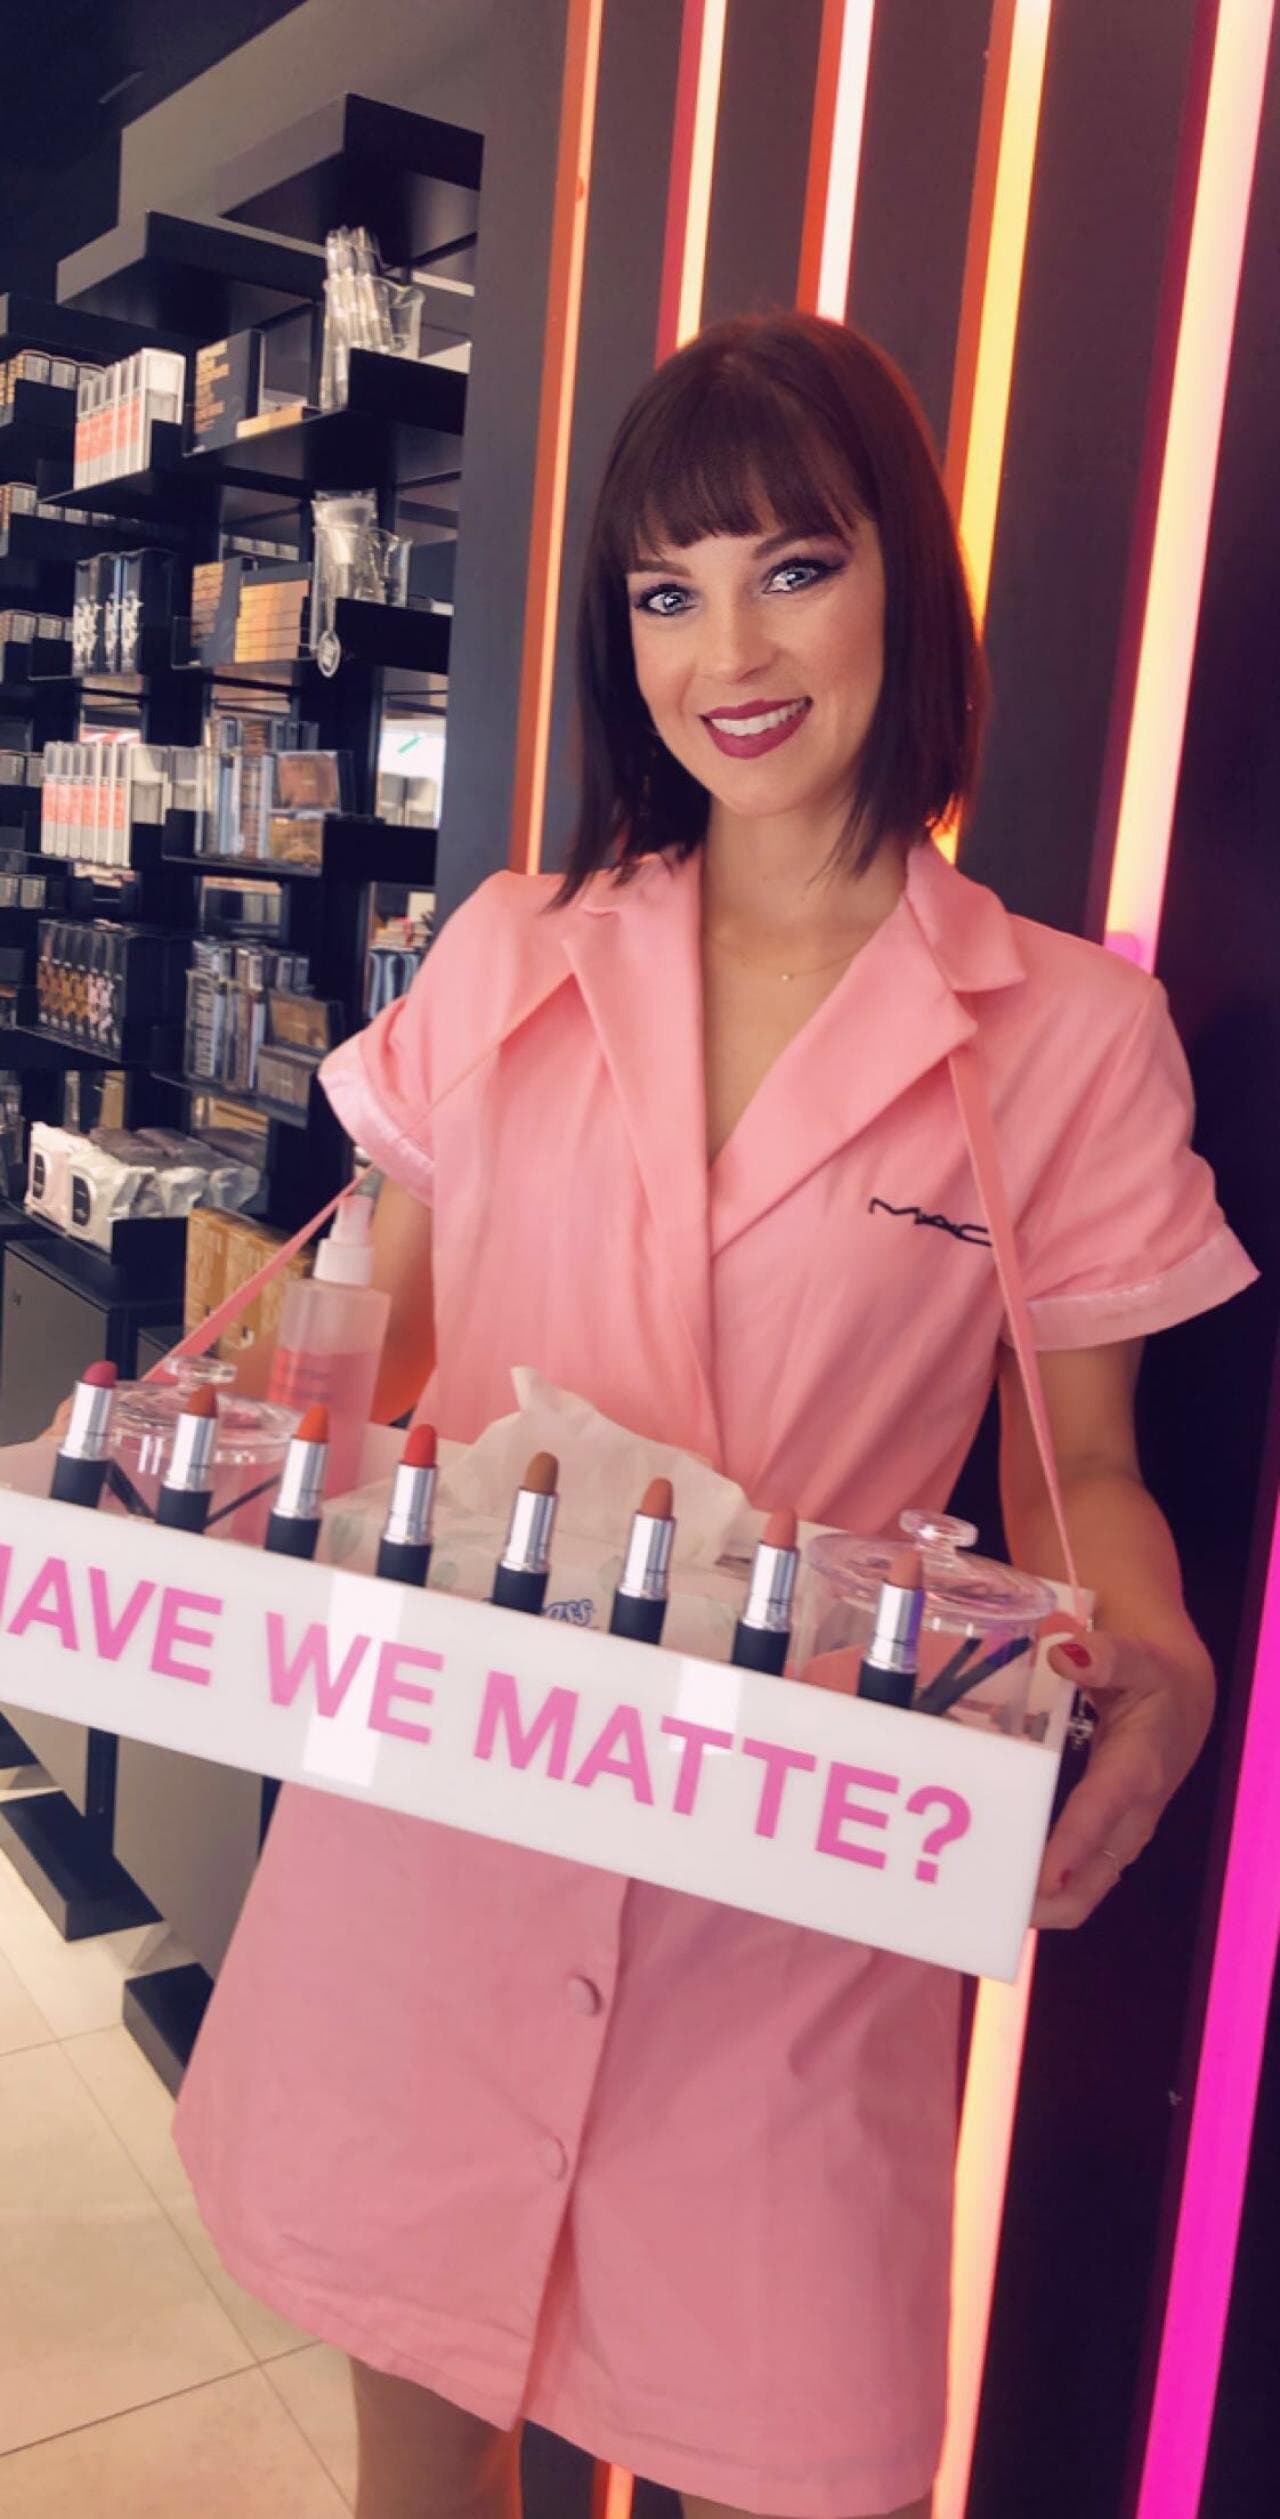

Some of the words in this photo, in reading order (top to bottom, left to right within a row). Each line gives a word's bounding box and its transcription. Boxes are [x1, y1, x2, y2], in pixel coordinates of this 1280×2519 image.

[867, 1196, 993, 1248] MAC
[0, 1543, 223, 1686] AVE
[266, 1612, 445, 1745] WE
[474, 1671, 973, 1884] MATTE?
